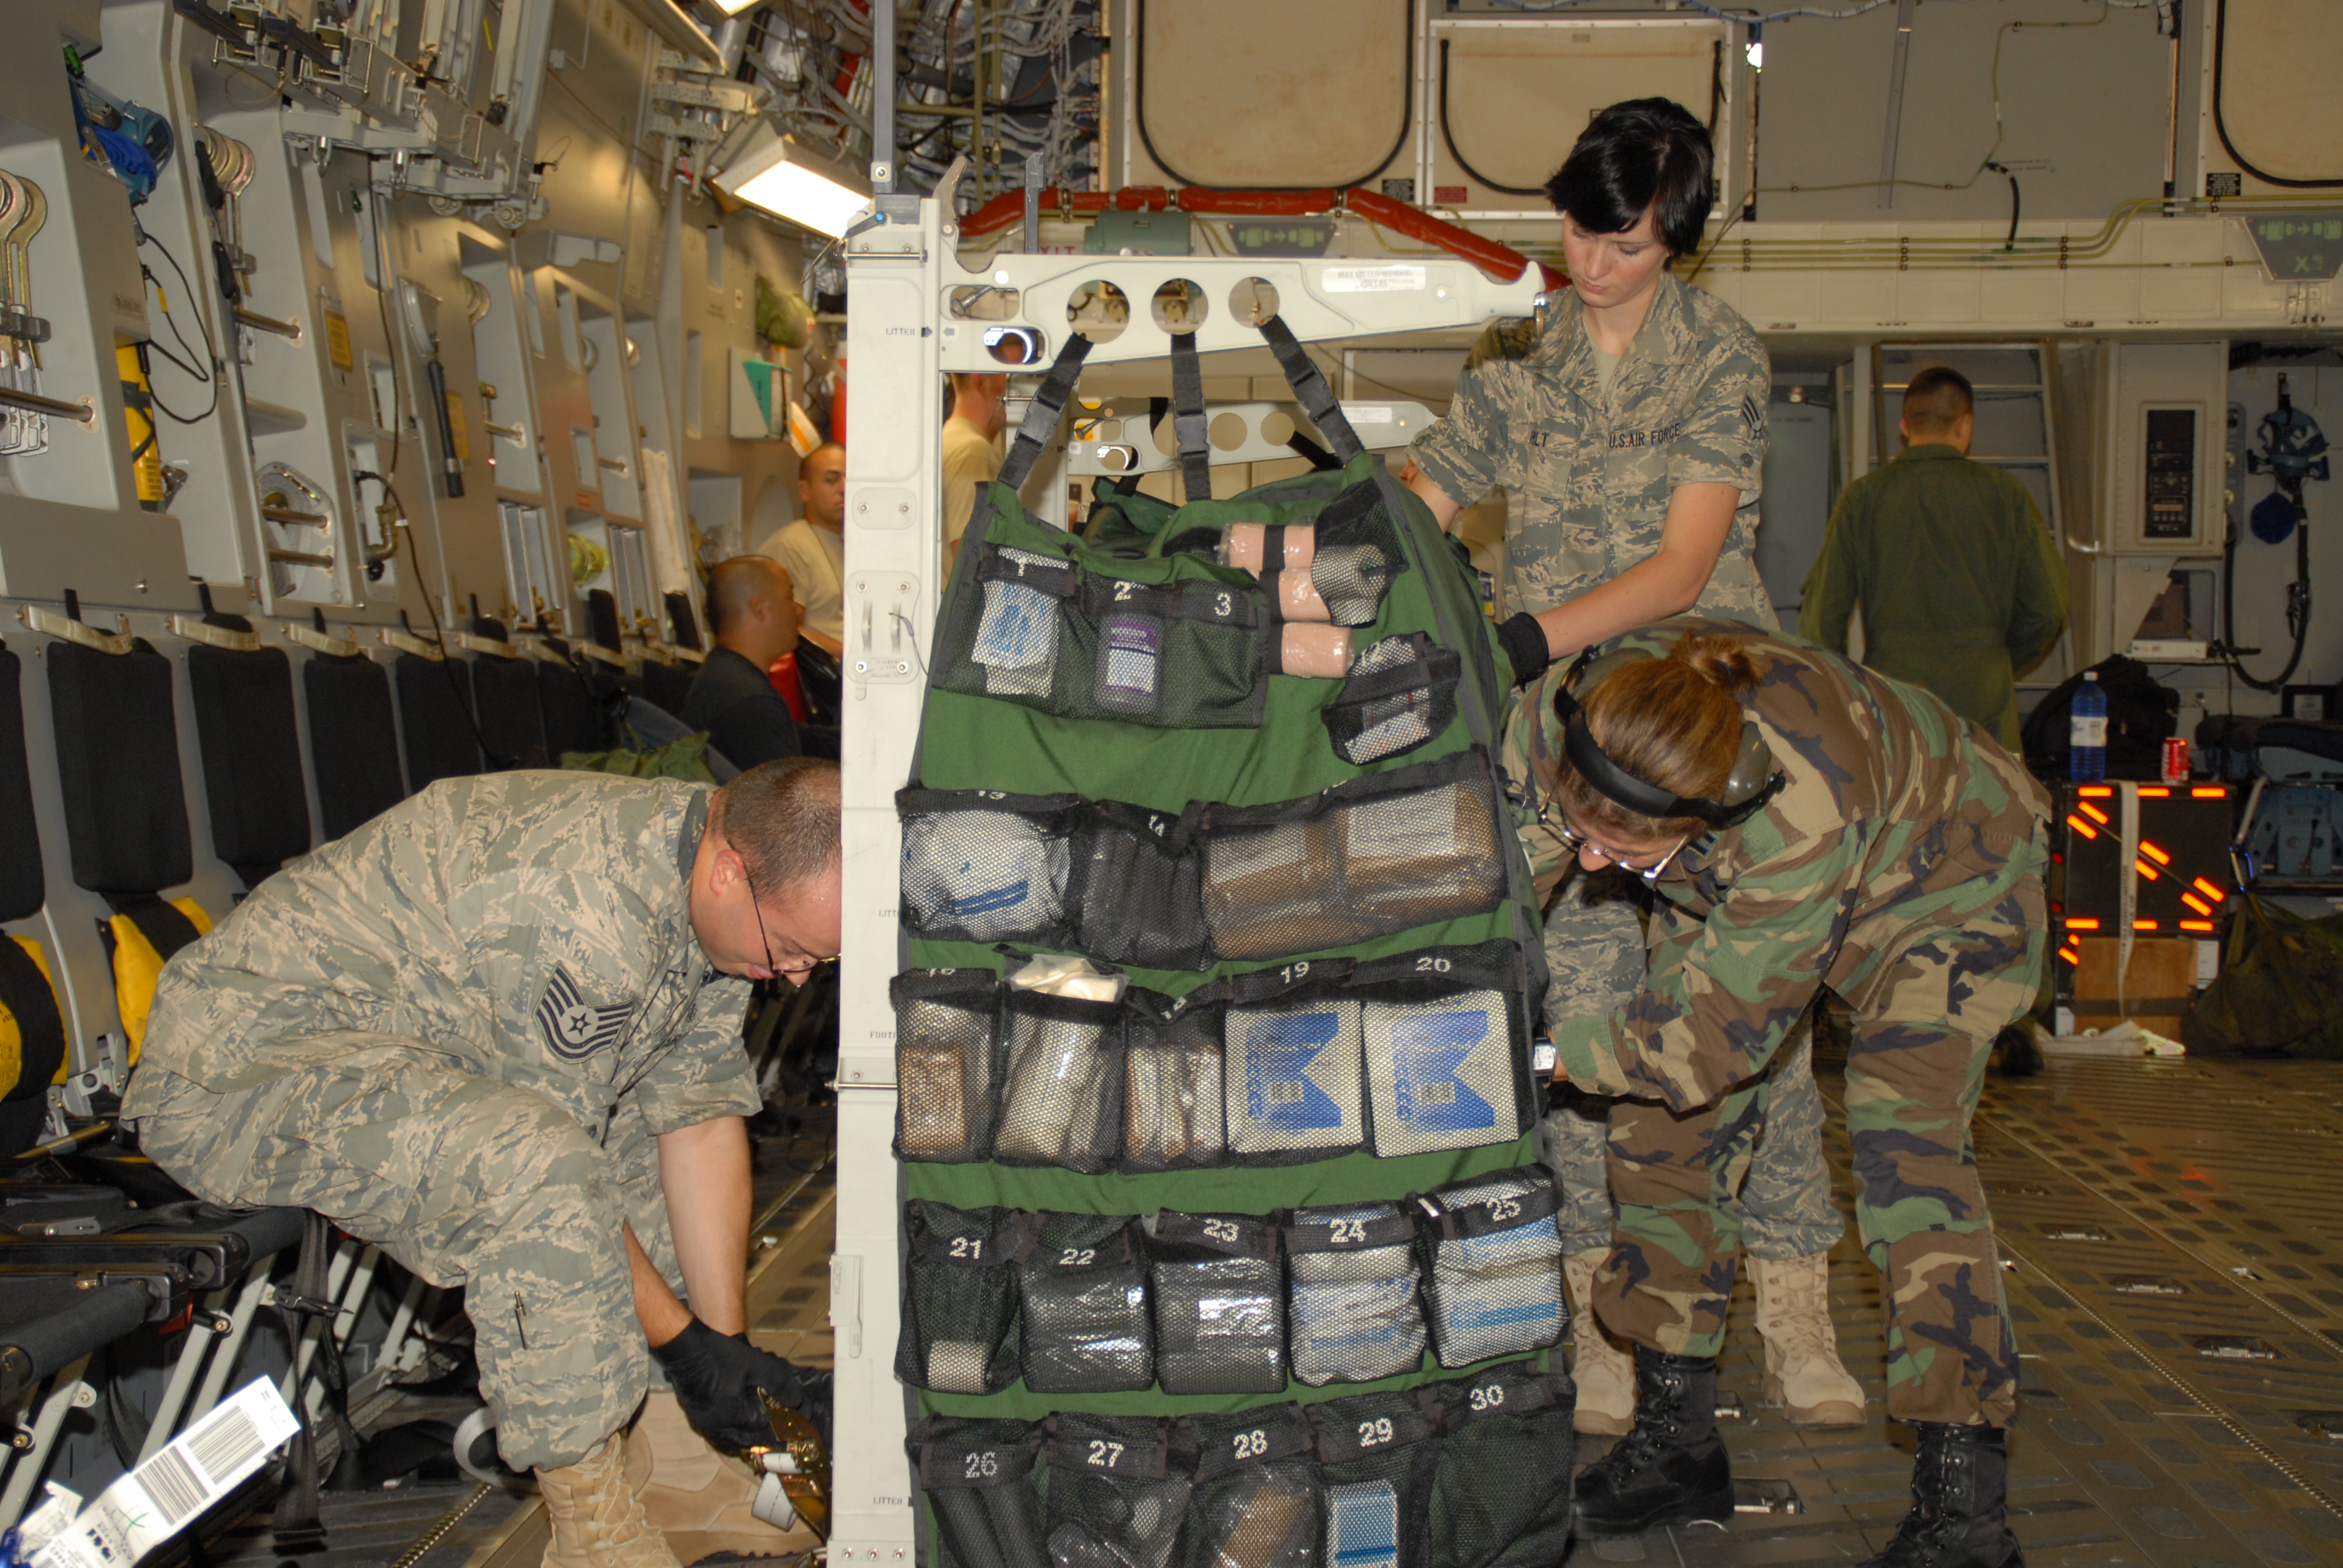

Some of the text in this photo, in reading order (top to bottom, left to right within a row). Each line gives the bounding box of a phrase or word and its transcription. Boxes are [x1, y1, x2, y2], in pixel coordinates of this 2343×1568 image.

[1651, 423, 1680, 445] FORCE
[1114, 581, 1131, 601] 2
[1214, 593, 1231, 616] 3
[1280, 961, 1309, 984] 19
[1415, 957, 1451, 973] 20
[1486, 1197, 1521, 1222] 25
[1202, 1218, 1240, 1243] 23
[1329, 1218, 1367, 1243] 24
[949, 1236, 982, 1259] 21
[1059, 1248, 1096, 1266] 22
[1469, 1385, 1505, 1411] 30
[1233, 1429, 1268, 1460] 28
[1358, 1417, 1394, 1448] 29
[965, 1451, 998, 1479] 26
[1087, 1440, 1124, 1468] 27
[873, 1497, 902, 1505] LITTER
